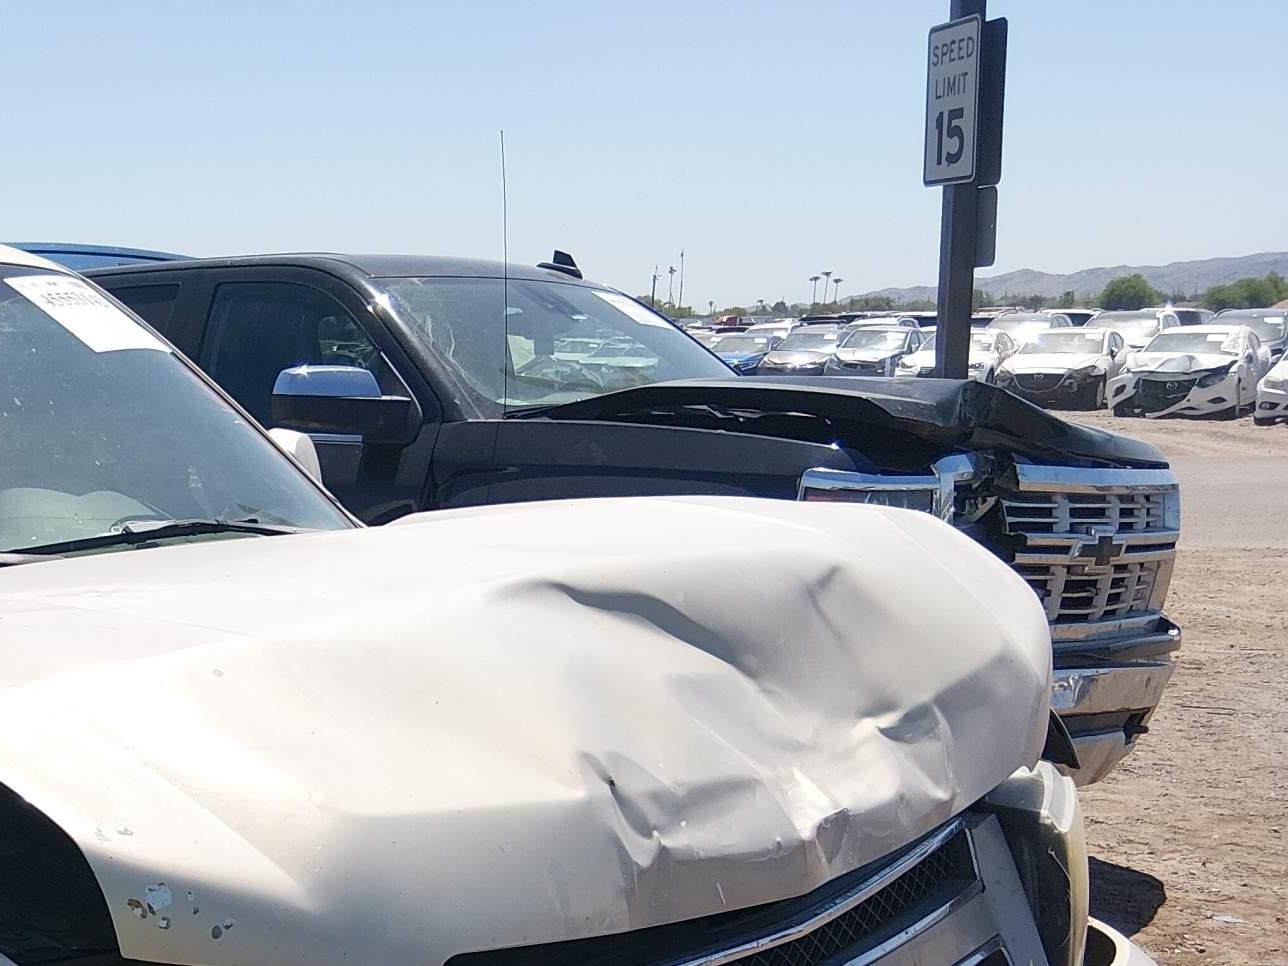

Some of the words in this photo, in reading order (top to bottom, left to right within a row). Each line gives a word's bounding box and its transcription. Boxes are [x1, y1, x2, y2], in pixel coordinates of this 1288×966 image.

[931, 36, 975, 67] SPEED
[935, 72, 969, 100] LIMIT
[935, 107, 965, 167] 15
